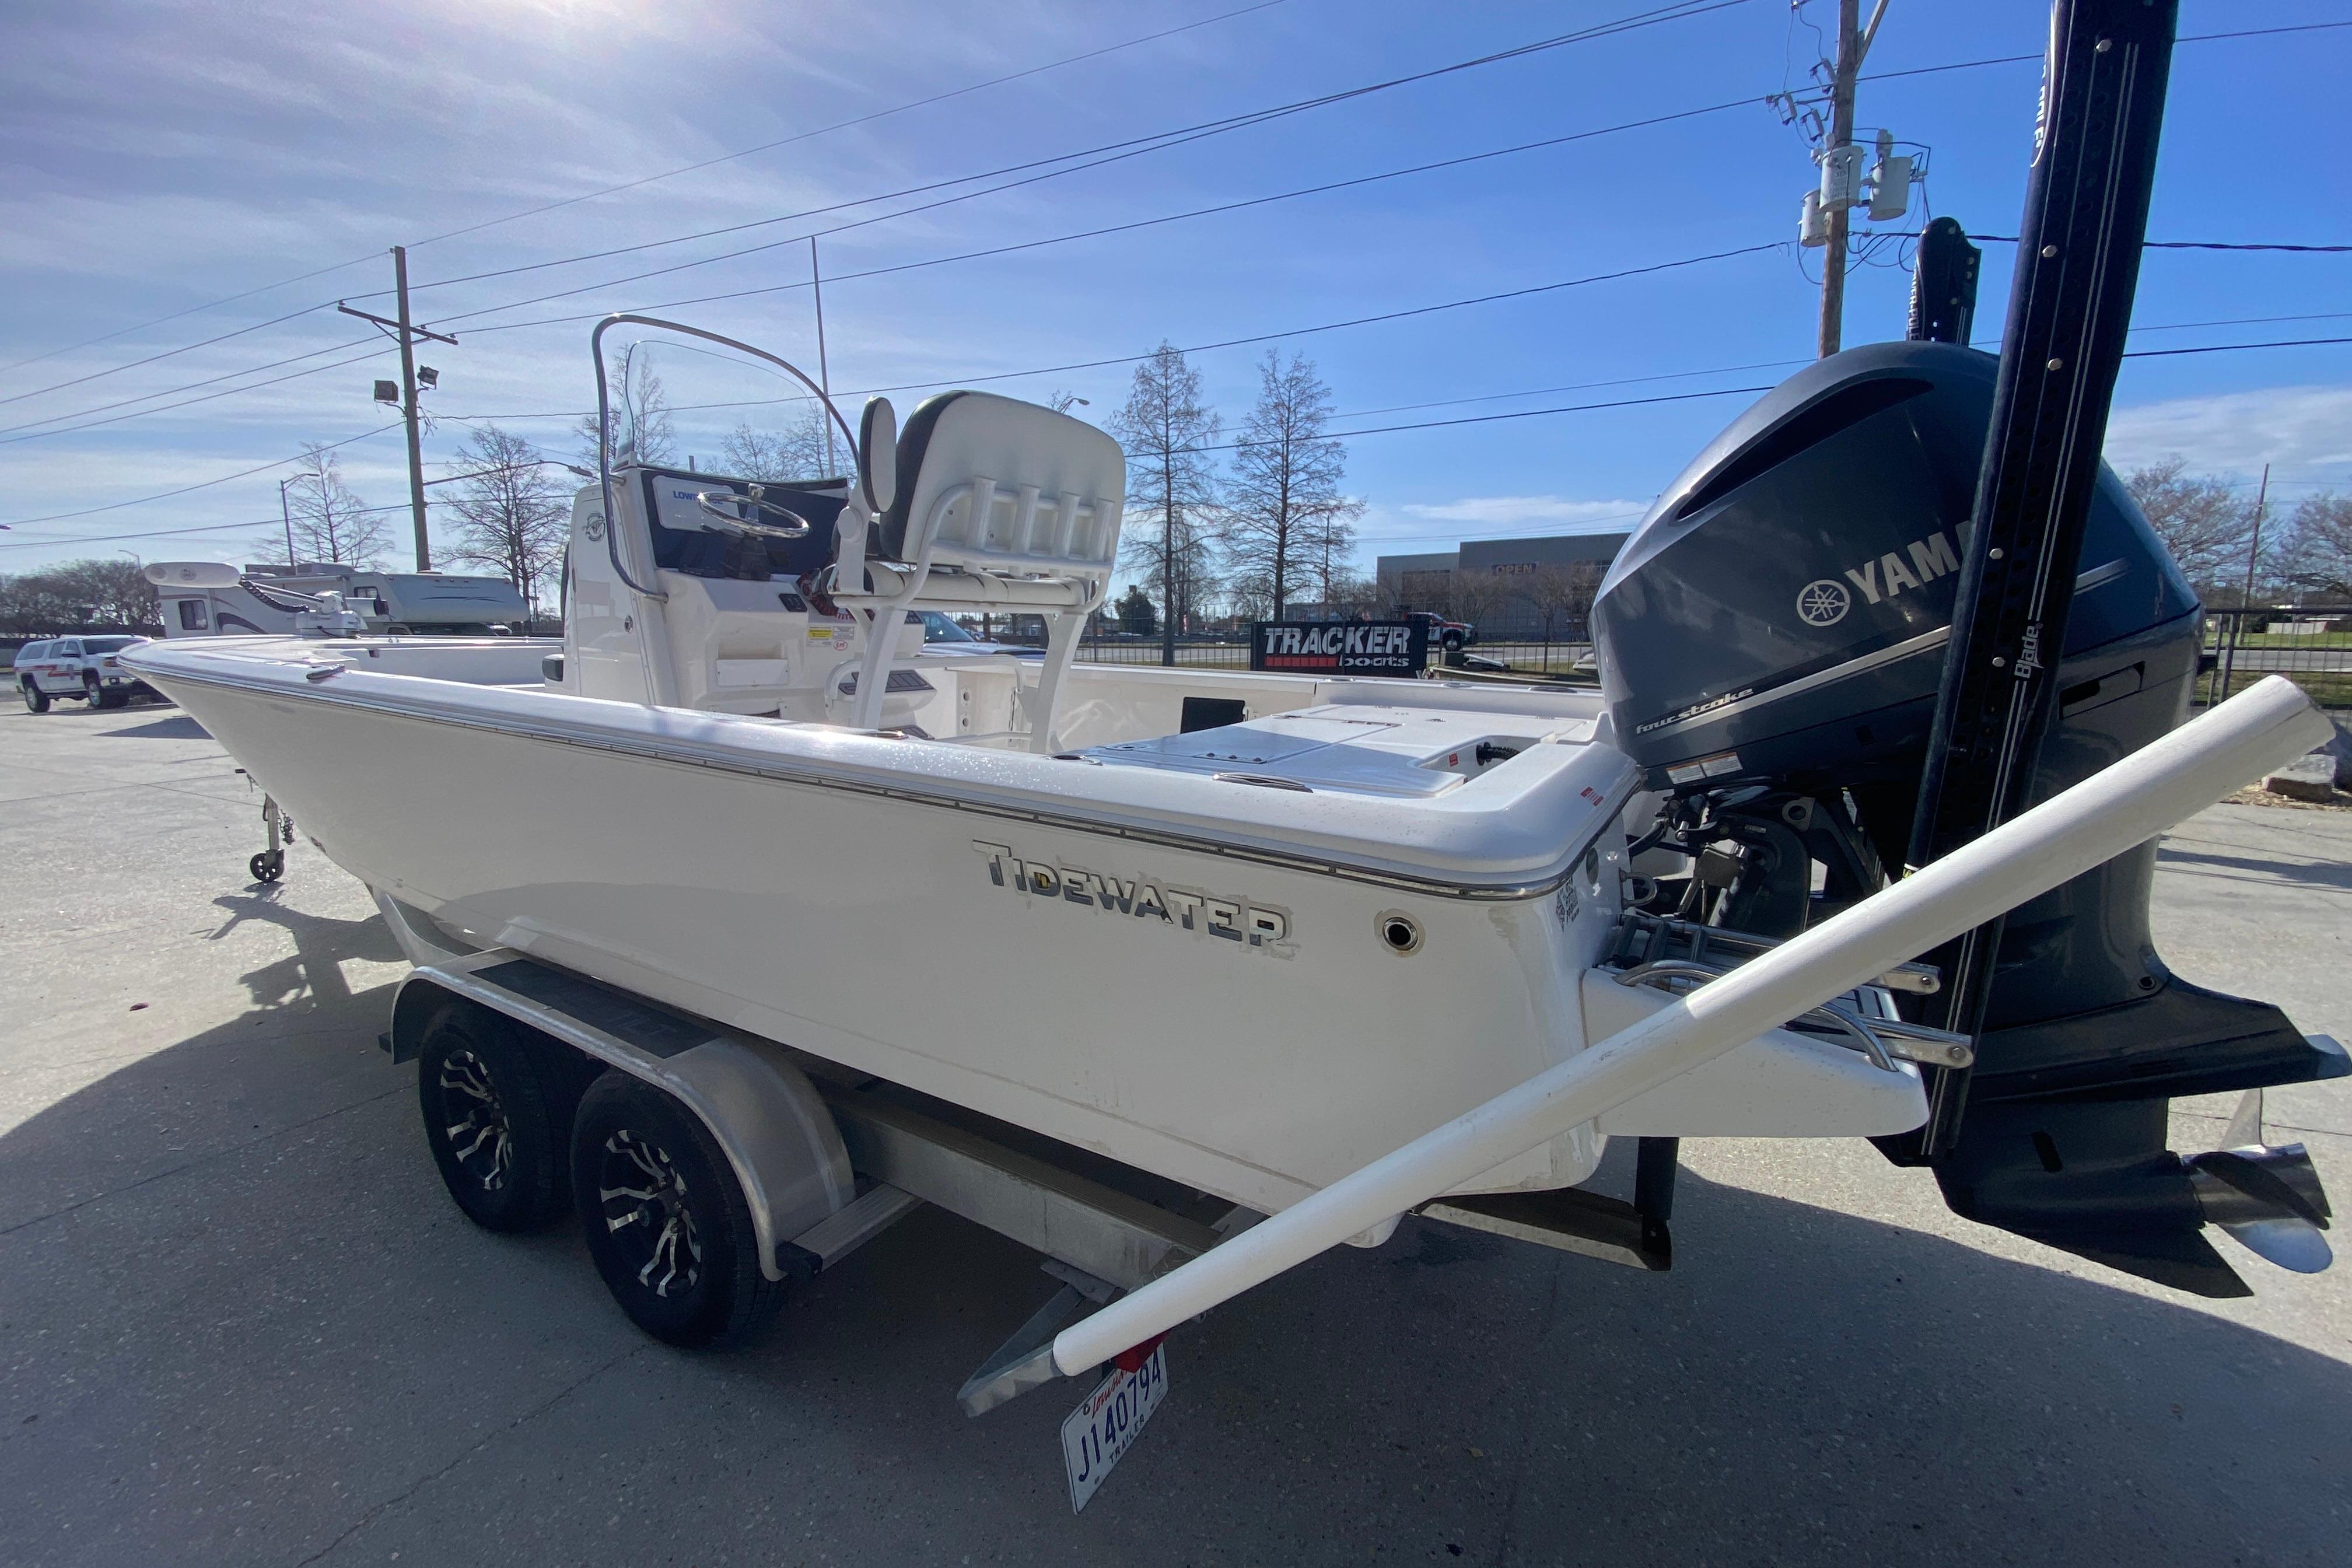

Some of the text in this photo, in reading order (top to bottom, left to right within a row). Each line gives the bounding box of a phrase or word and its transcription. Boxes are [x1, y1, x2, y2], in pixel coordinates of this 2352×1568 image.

[673, 491, 723, 505] LOWCE
[1265, 626, 1410, 654] TRACKER
[1339, 654, 1409, 667] boats
[2014, 625, 2041, 678] Blade
[972, 839, 1287, 947] TIDEWATER
[1078, 1349, 1160, 1482] J140794
[1091, 1370, 1127, 1419] Louisia
[1109, 1413, 1144, 1464] TRAILER
